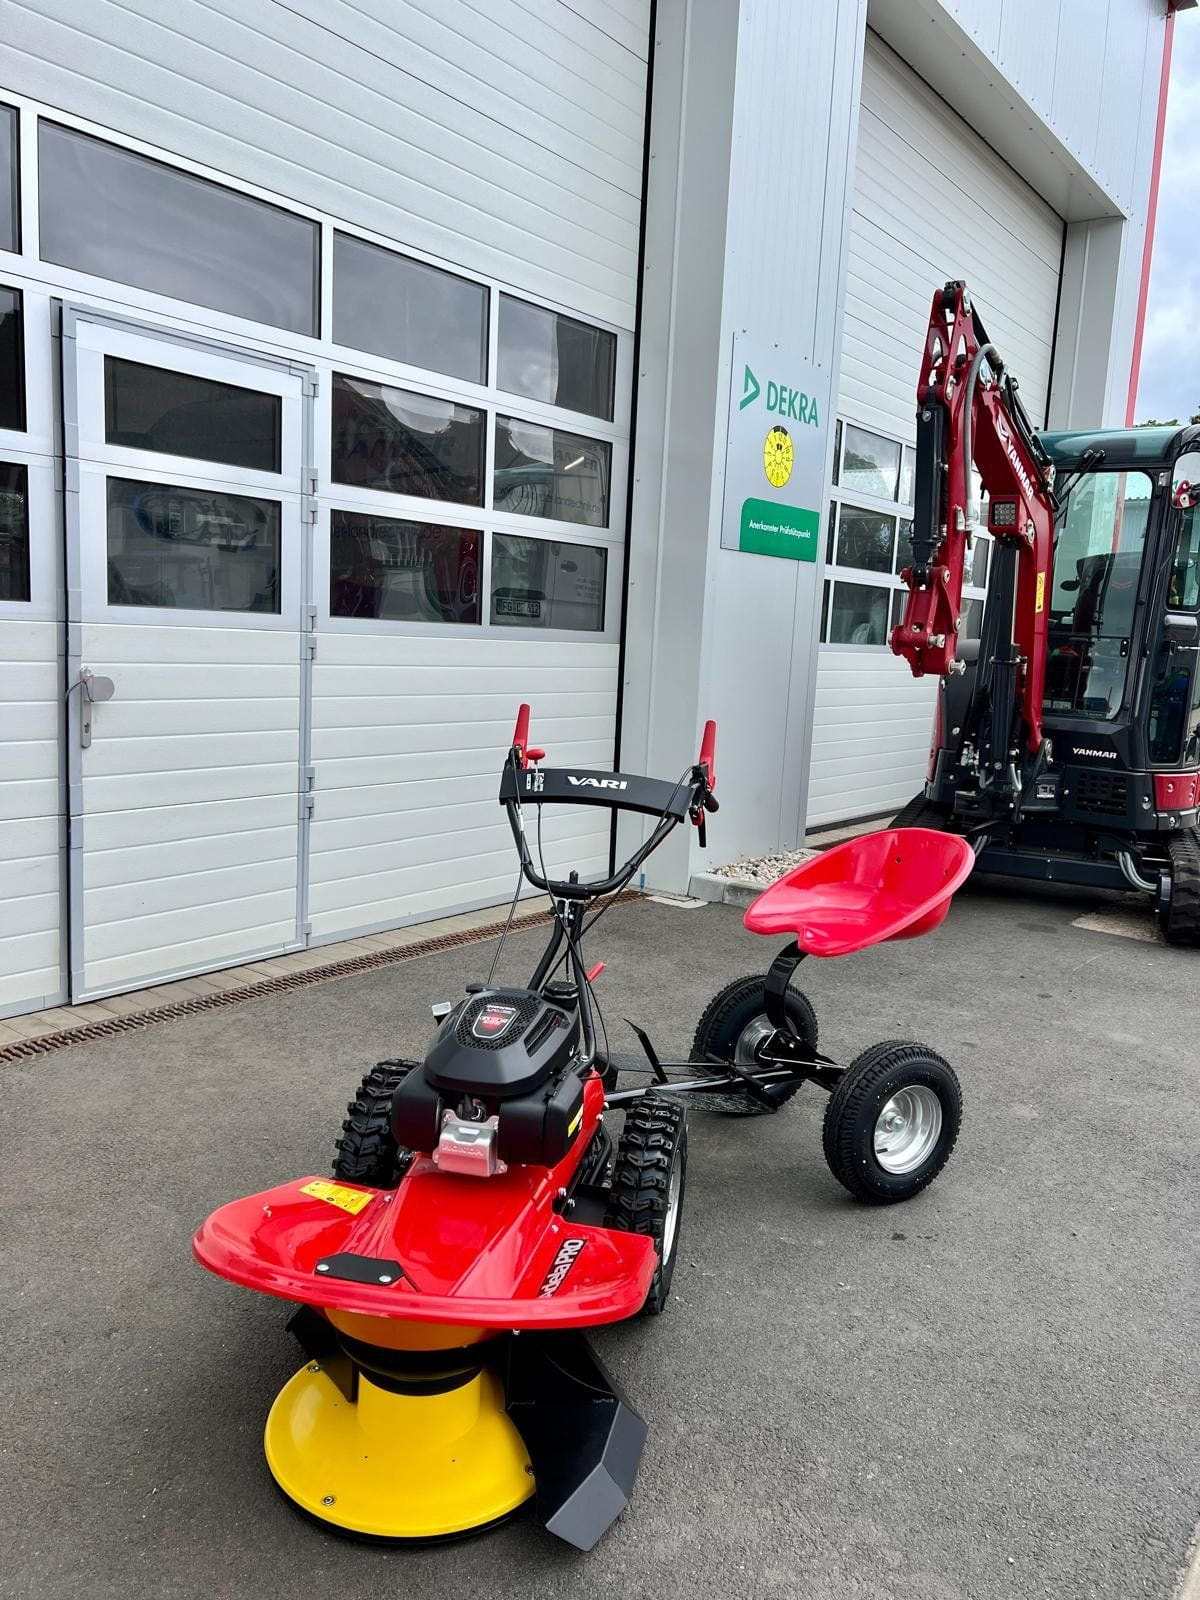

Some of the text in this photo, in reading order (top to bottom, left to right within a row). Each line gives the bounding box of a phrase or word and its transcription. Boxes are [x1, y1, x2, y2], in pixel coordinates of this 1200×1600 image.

[766, 380, 819, 428] DEKRA
[1007, 440, 1034, 501] YANMAR
[1072, 747, 1118, 760] YANMAR
[567, 775, 628, 790] VARI
